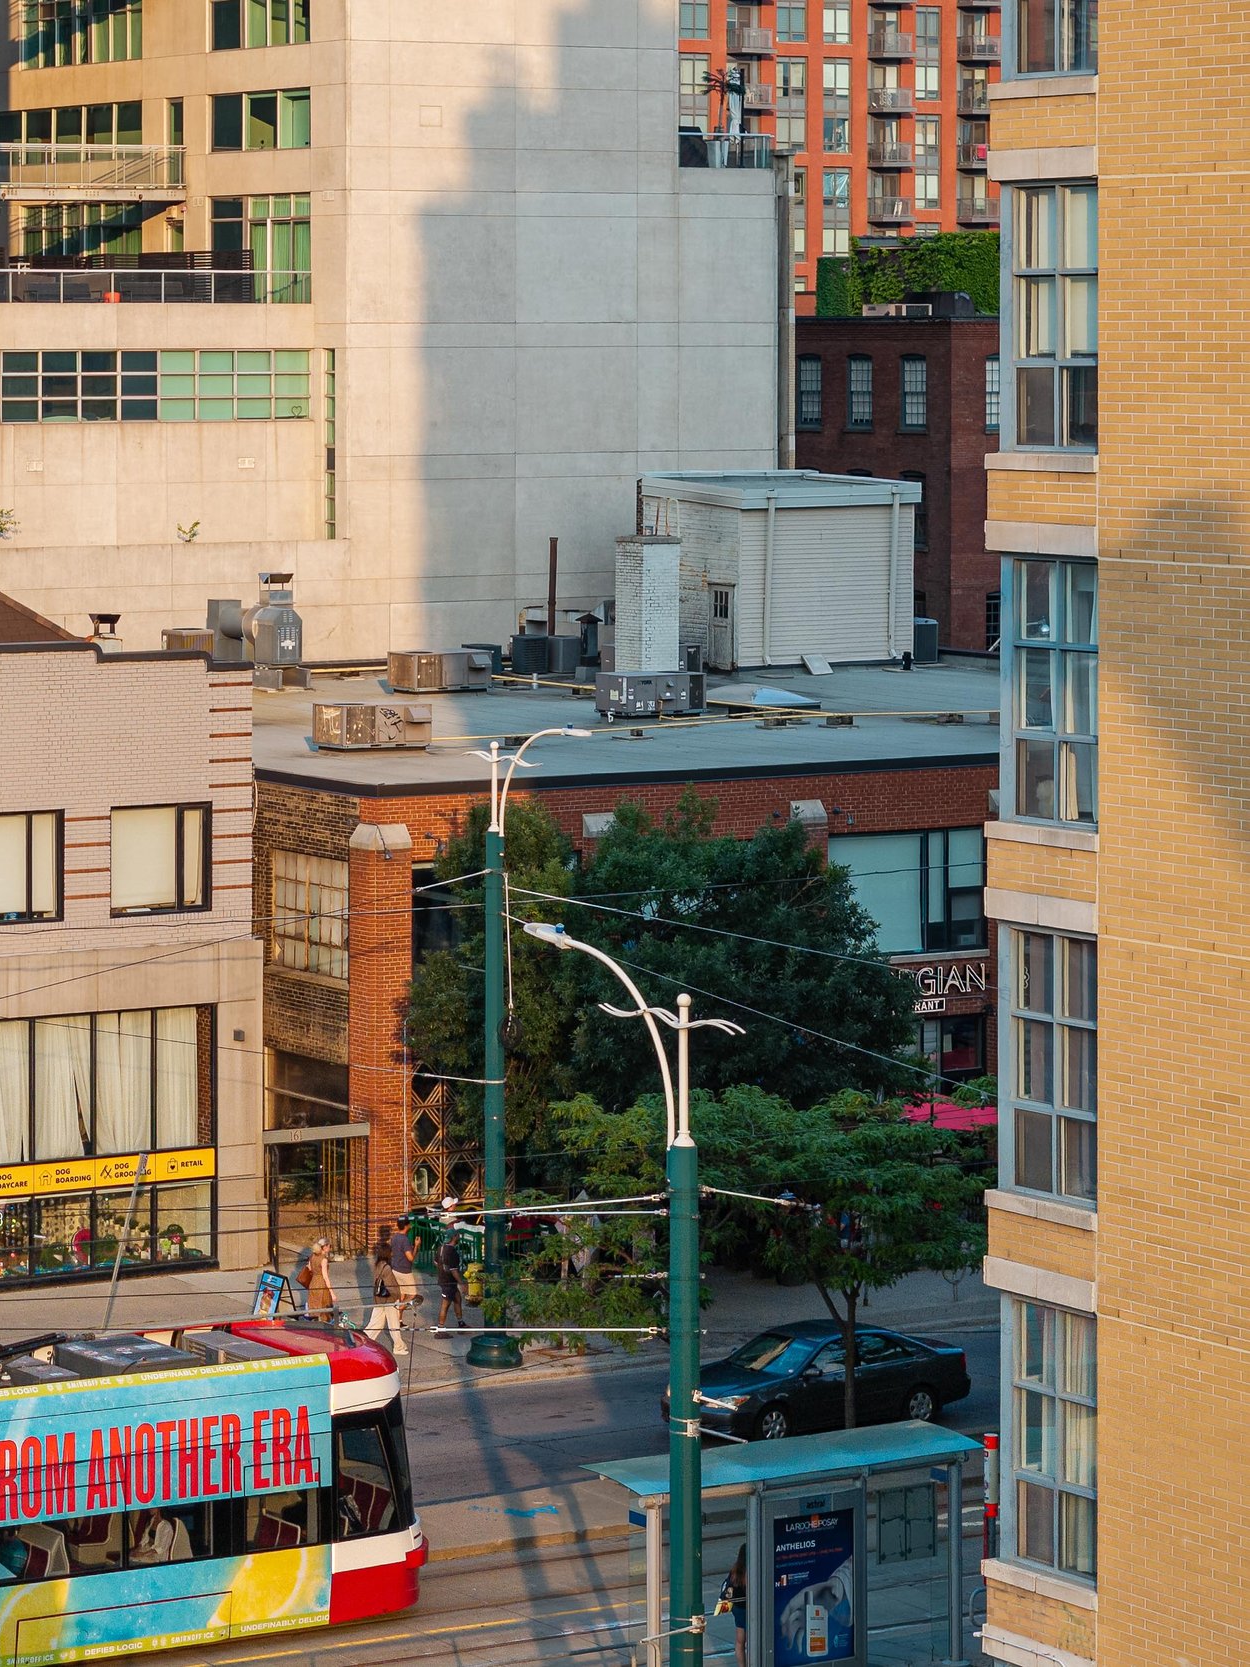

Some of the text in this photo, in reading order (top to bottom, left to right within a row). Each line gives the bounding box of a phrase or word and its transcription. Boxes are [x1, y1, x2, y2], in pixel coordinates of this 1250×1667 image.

[899, 963, 985, 996] GIAN
[290, 1130, 302, 1142] 161
[114, 1162, 130, 1170] DOG
[180, 1160, 204, 1168] RETAIL
[55, 1168, 71, 1176] DOG
[114, 1169, 152, 1179] GROOG
[55, 1174, 92, 1184] BOARDING
[11, 1386, 39, 1396] LOGIC
[140, 1367, 198, 1382] UNDEFINABLY
[200, 1364, 245, 1375] DELICIOUS
[86, 1413, 243, 1511] ANOTHER
[253, 1405, 320, 1489] ERA.
[775, 1540, 816, 1552] ANTHELIOS
[84, 1646, 115, 1657] DEFIES
[116, 1642, 143, 1652] LOGIC
[203, 1631, 215, 1640] ICE
[240, 1620, 296, 1633] UNDEFINABLY
